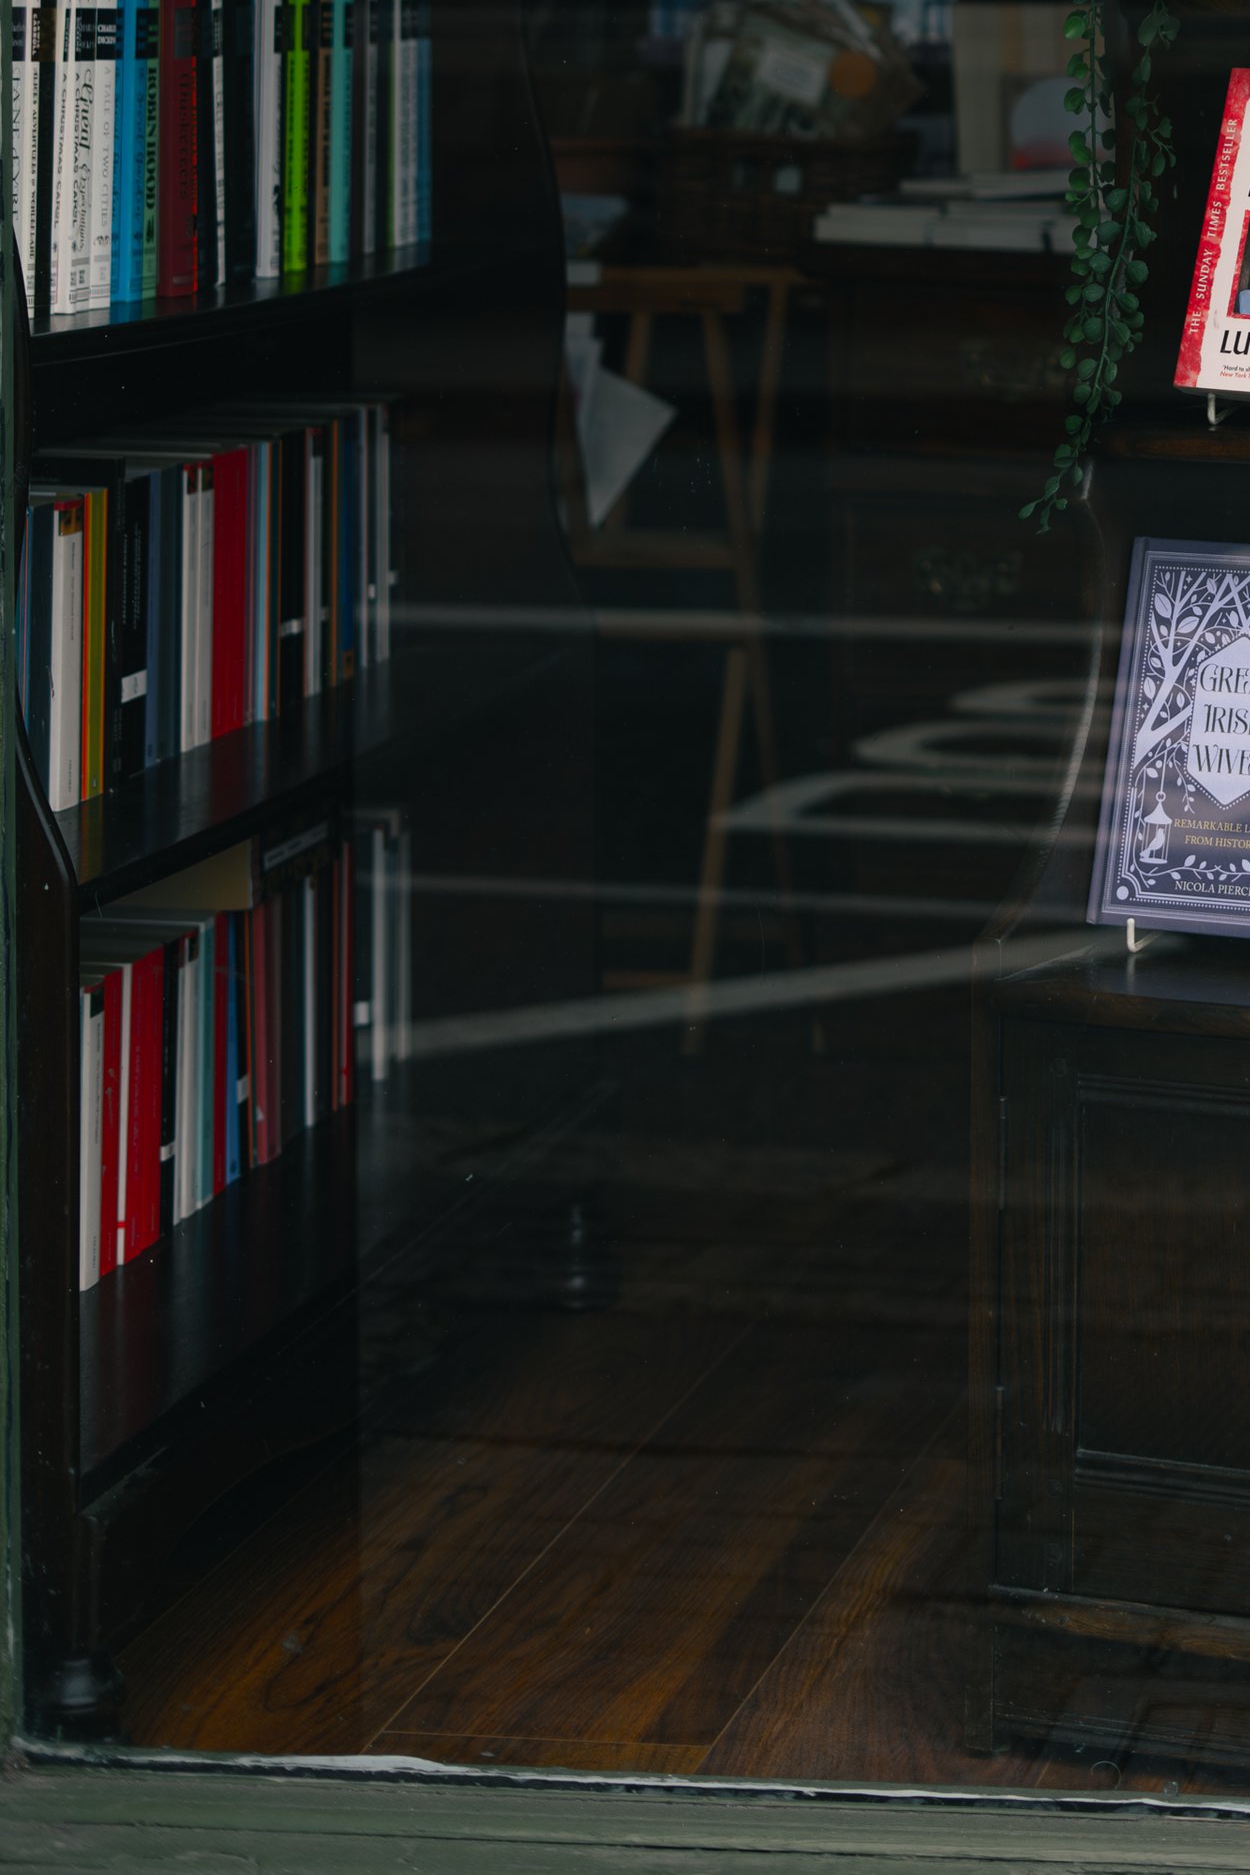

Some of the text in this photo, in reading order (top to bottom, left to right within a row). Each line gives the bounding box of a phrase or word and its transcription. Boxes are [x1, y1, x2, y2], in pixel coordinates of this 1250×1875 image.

[105, 66, 111, 75] A
[78, 69, 94, 155] Great
[103, 121, 110, 137] OF
[146, 67, 157, 209] ROBIN HOOD
[102, 147, 110, 178] TWO
[101, 183, 109, 228] CITIES
[1188, 117, 1238, 335] THE SUNDAY TIMES BESTSELLER
[1174, 819, 1242, 832] REMARKABLE
[1185, 835, 1213, 845] FROM
[1175, 881, 1215, 893] NICOLA
